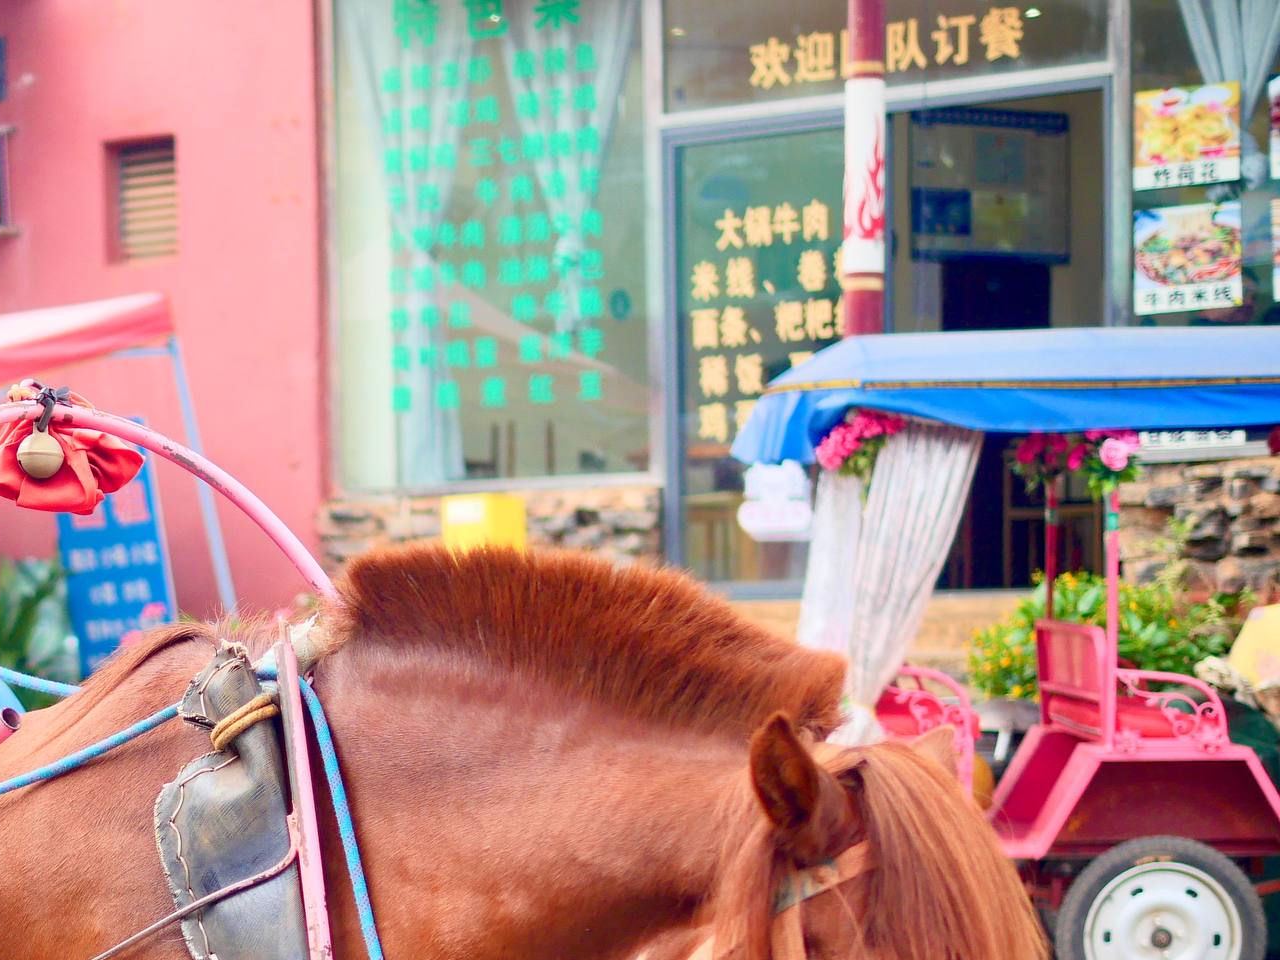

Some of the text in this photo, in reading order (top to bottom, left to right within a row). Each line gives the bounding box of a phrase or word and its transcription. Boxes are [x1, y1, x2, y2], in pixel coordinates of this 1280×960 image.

[748, 6, 1024, 90] 欢迎队订餐
[715, 198, 829, 251] 大锅牛肉
[1144, 285, 1233, 306] 牛肉米线
